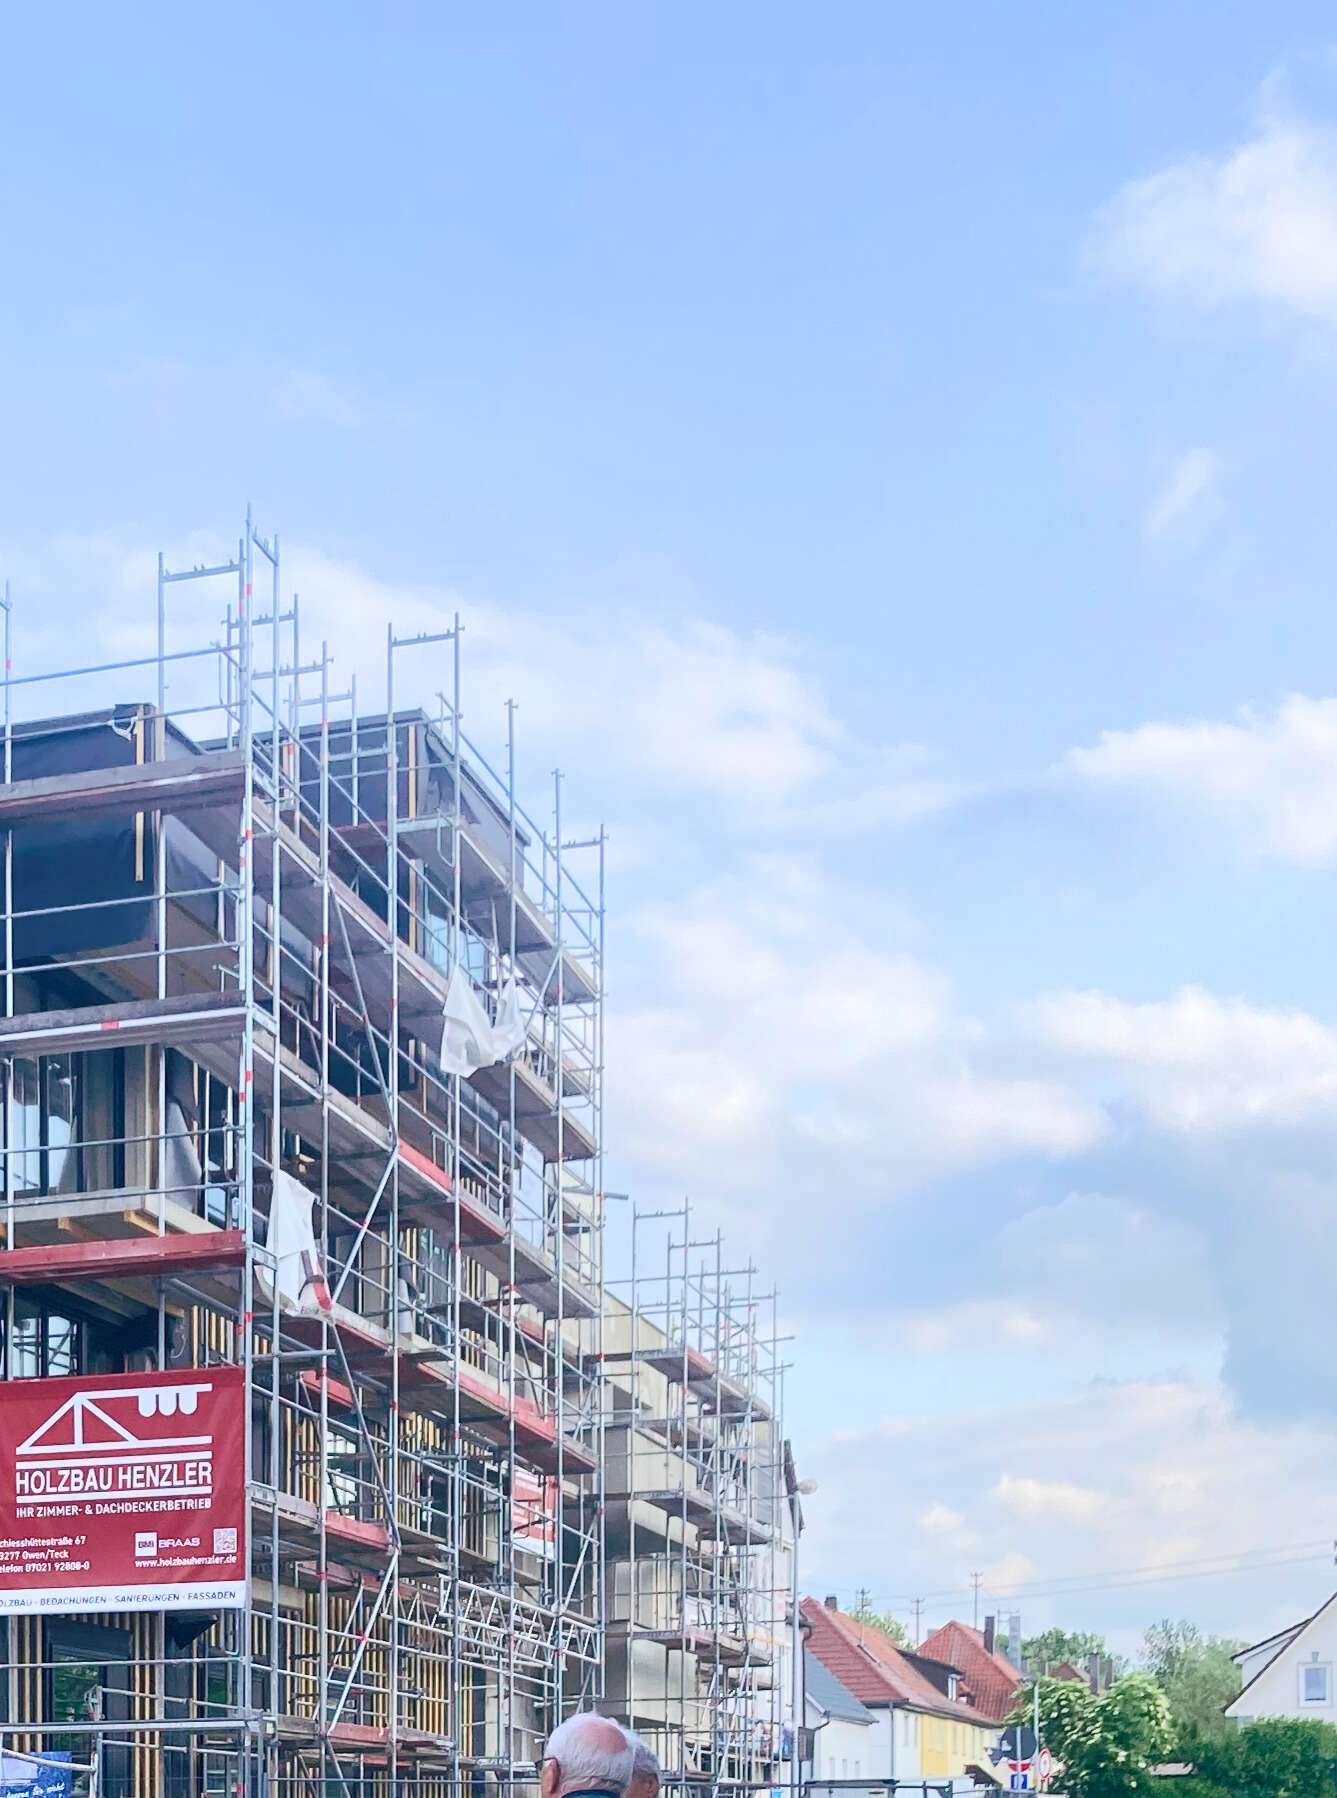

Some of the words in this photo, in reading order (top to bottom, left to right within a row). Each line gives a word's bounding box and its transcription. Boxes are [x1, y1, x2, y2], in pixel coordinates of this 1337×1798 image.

[16, 1468, 112, 1494] HOLZBAU
[118, 1461, 212, 1489] HENZLER
[16, 1506, 35, 1518] IHR
[37, 1504, 82, 1517] ZIMMER-
[85, 1503, 93, 1514] &
[95, 1498, 211, 1514] DACHDECKERBETRIEB
[74, 1535, 86, 1545] 67
[21, 1548, 70, 1561] Owen/Teck
[25, 1562, 52, 1573] 07021
[40, 1596, 107, 1606] BEDACHUNGEN
[114, 1593, 180, 1603] SANIERUNGEN
[187, 1590, 236, 1601] FASSADEN
